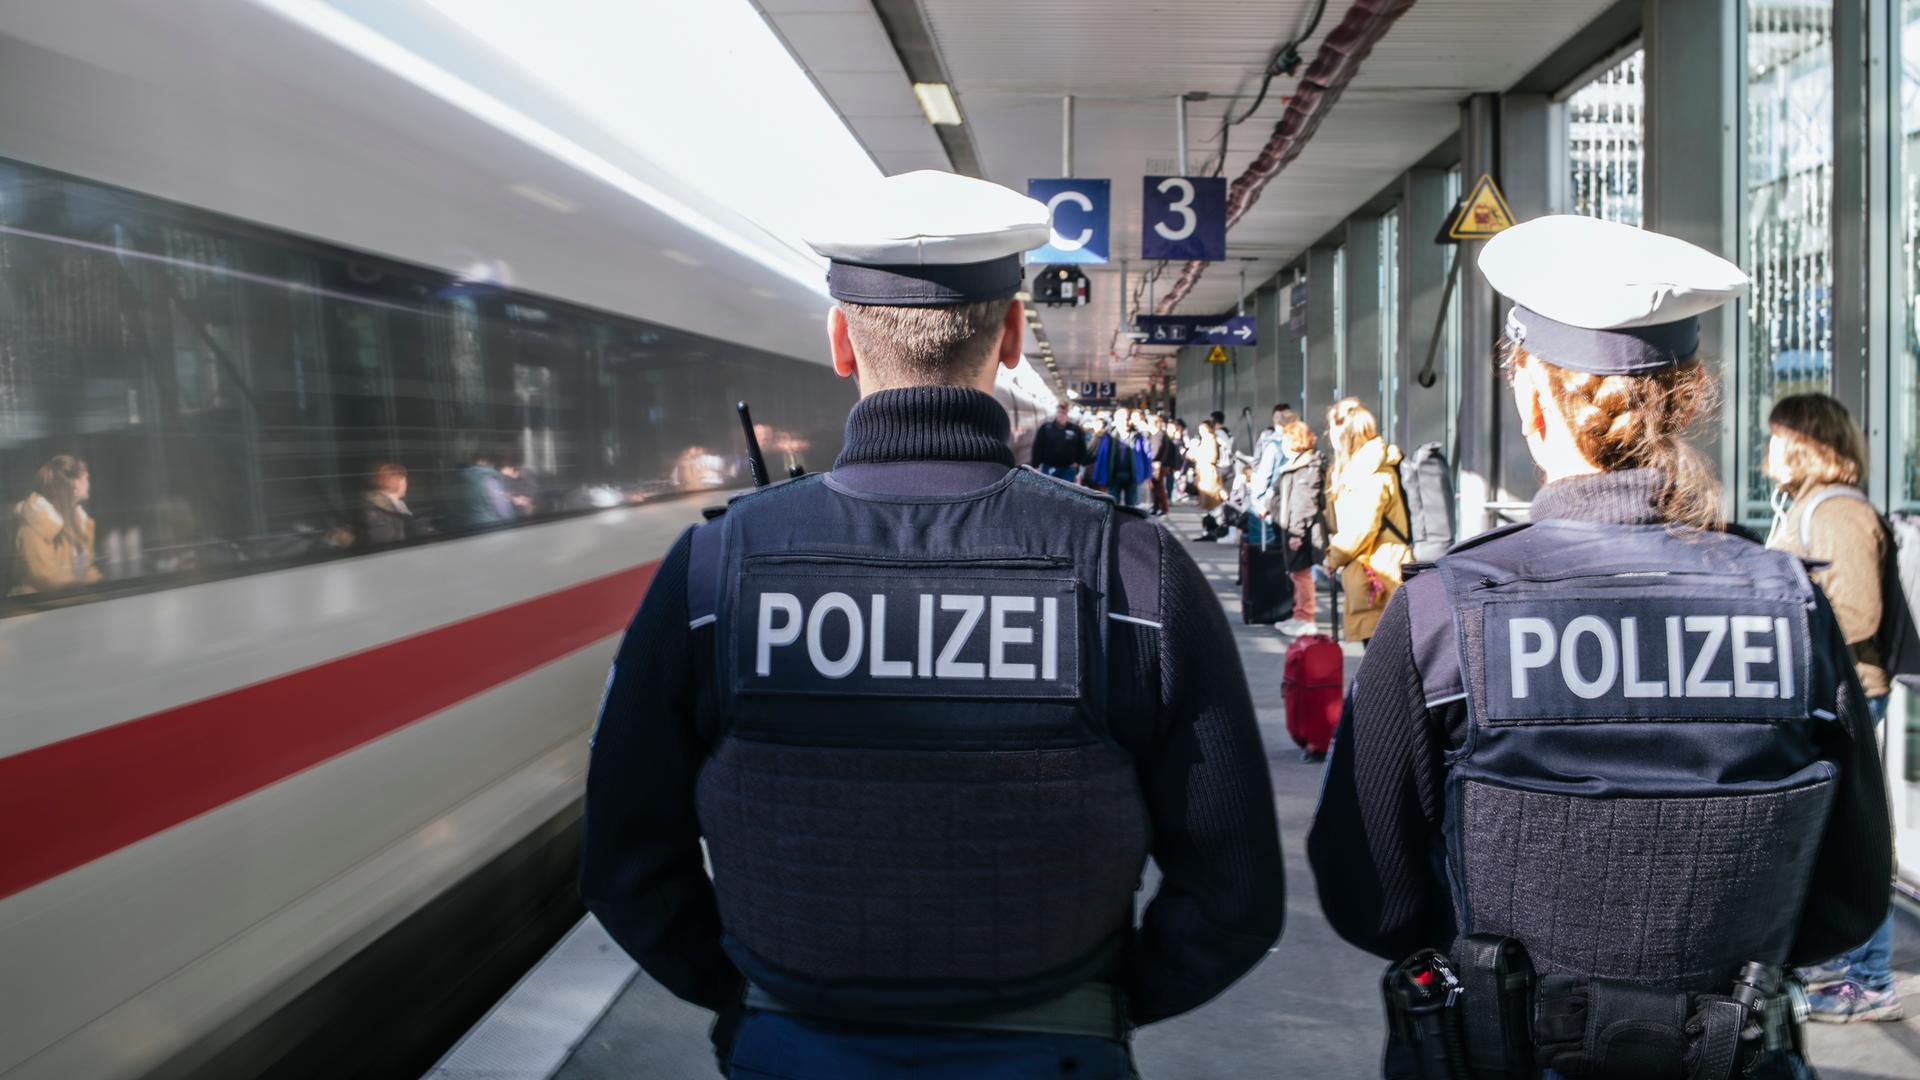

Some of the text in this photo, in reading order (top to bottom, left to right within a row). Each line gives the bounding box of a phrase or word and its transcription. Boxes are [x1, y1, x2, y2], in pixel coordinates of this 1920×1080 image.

[1048, 191, 1093, 251] C
[1154, 178, 1197, 241] 3
[1083, 383, 1092, 394] D
[1102, 383, 1111, 396] 3
[756, 592, 1059, 680] POLIZEI
[1509, 615, 1794, 699] POLIZEI
